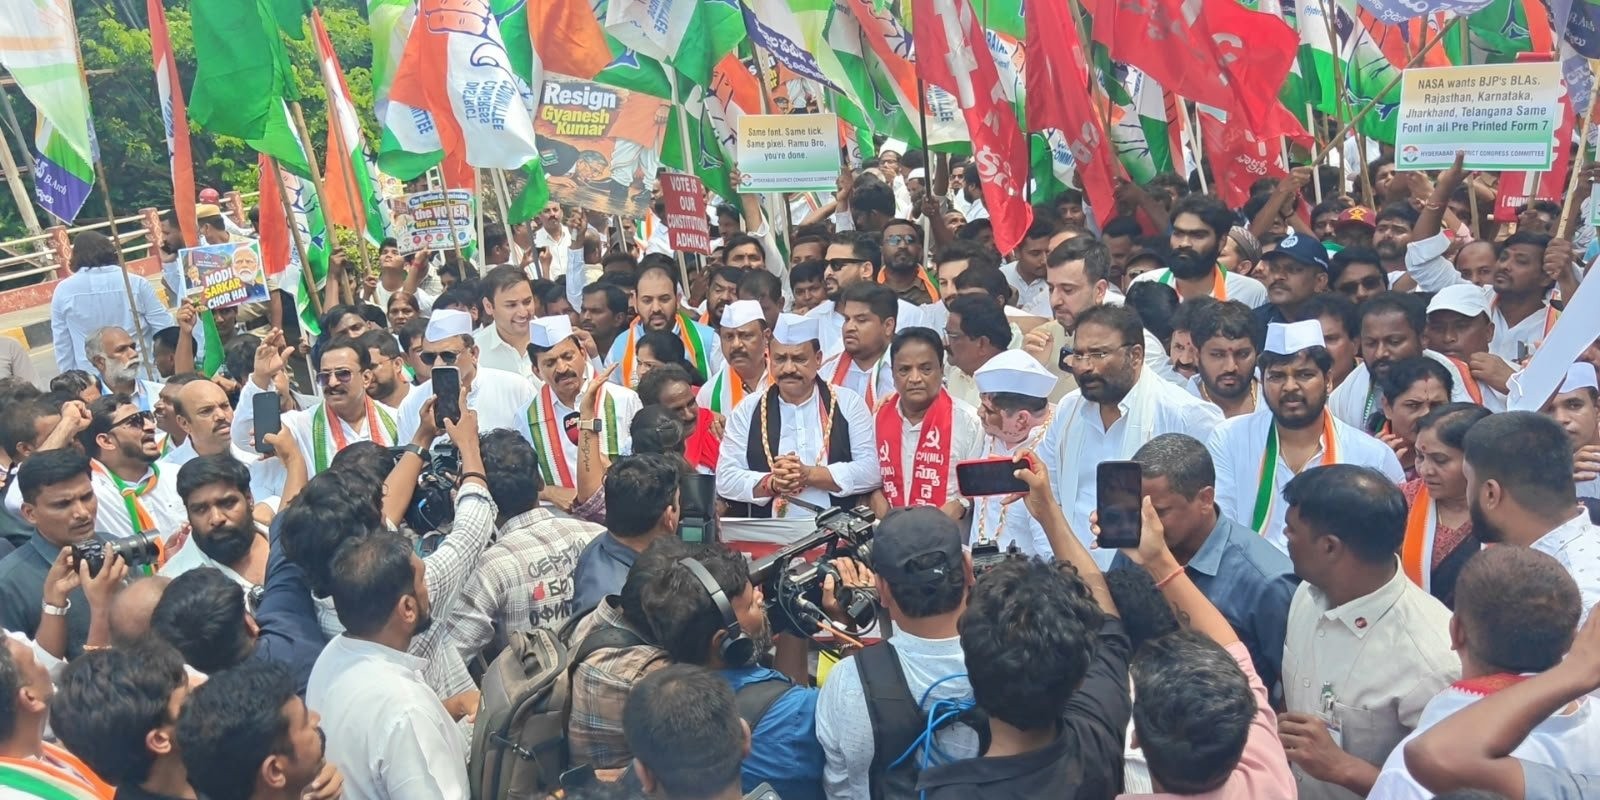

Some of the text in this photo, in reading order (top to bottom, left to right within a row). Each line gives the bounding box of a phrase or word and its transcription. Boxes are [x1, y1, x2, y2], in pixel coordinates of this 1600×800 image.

[1418, 78, 1444, 89] NASA
[1447, 77, 1476, 88] wants
[1479, 76, 1506, 87] BJP's
[543, 82, 617, 110] Resign
[1424, 91, 1533, 105] Rajasthan, Karnataka,
[541, 105, 610, 124] Gyanesh
[1406, 105, 1547, 119] Jharkhand, Telangana Same
[556, 121, 606, 136] Kumar
[748, 126, 823, 137] Same font. Same tick.
[1402, 120, 1549, 133] Font in all Pre Printed Form 7
[746, 139, 766, 148] Same
[767, 139, 785, 149] pixel.
[788, 139, 809, 147] Ramu
[764, 151, 808, 161] you're done.
[43, 174, 68, 195] B.Arch
[670, 176, 698, 194] VOTE IS
[680, 195, 697, 212] OUR
[414, 205, 468, 221] the VOER
[205, 267, 233, 287] MODI
[204, 278, 242, 299] SARKAR
[207, 288, 248, 310] CHOR HAI
[916, 451, 944, 465] CPI(ML)
